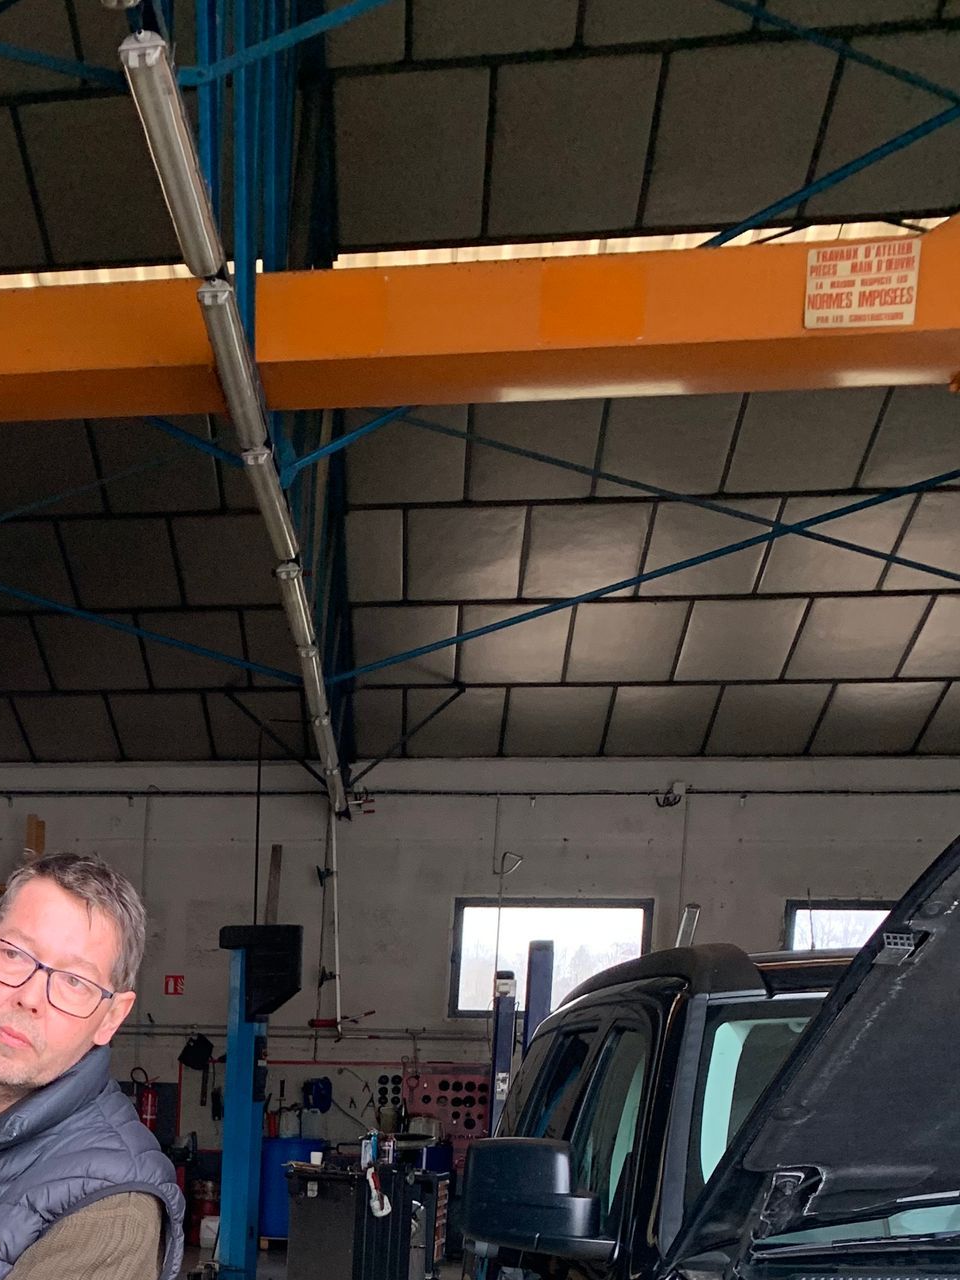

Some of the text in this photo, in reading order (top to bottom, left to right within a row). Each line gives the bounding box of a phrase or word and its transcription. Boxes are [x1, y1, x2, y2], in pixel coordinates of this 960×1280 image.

[816, 242, 913, 263] TRAVAUX D'ATELIER
[850, 260, 873, 274] MAIN
[815, 281, 823, 290] LA
[807, 287, 914, 310] NORMES IMPOSEES
